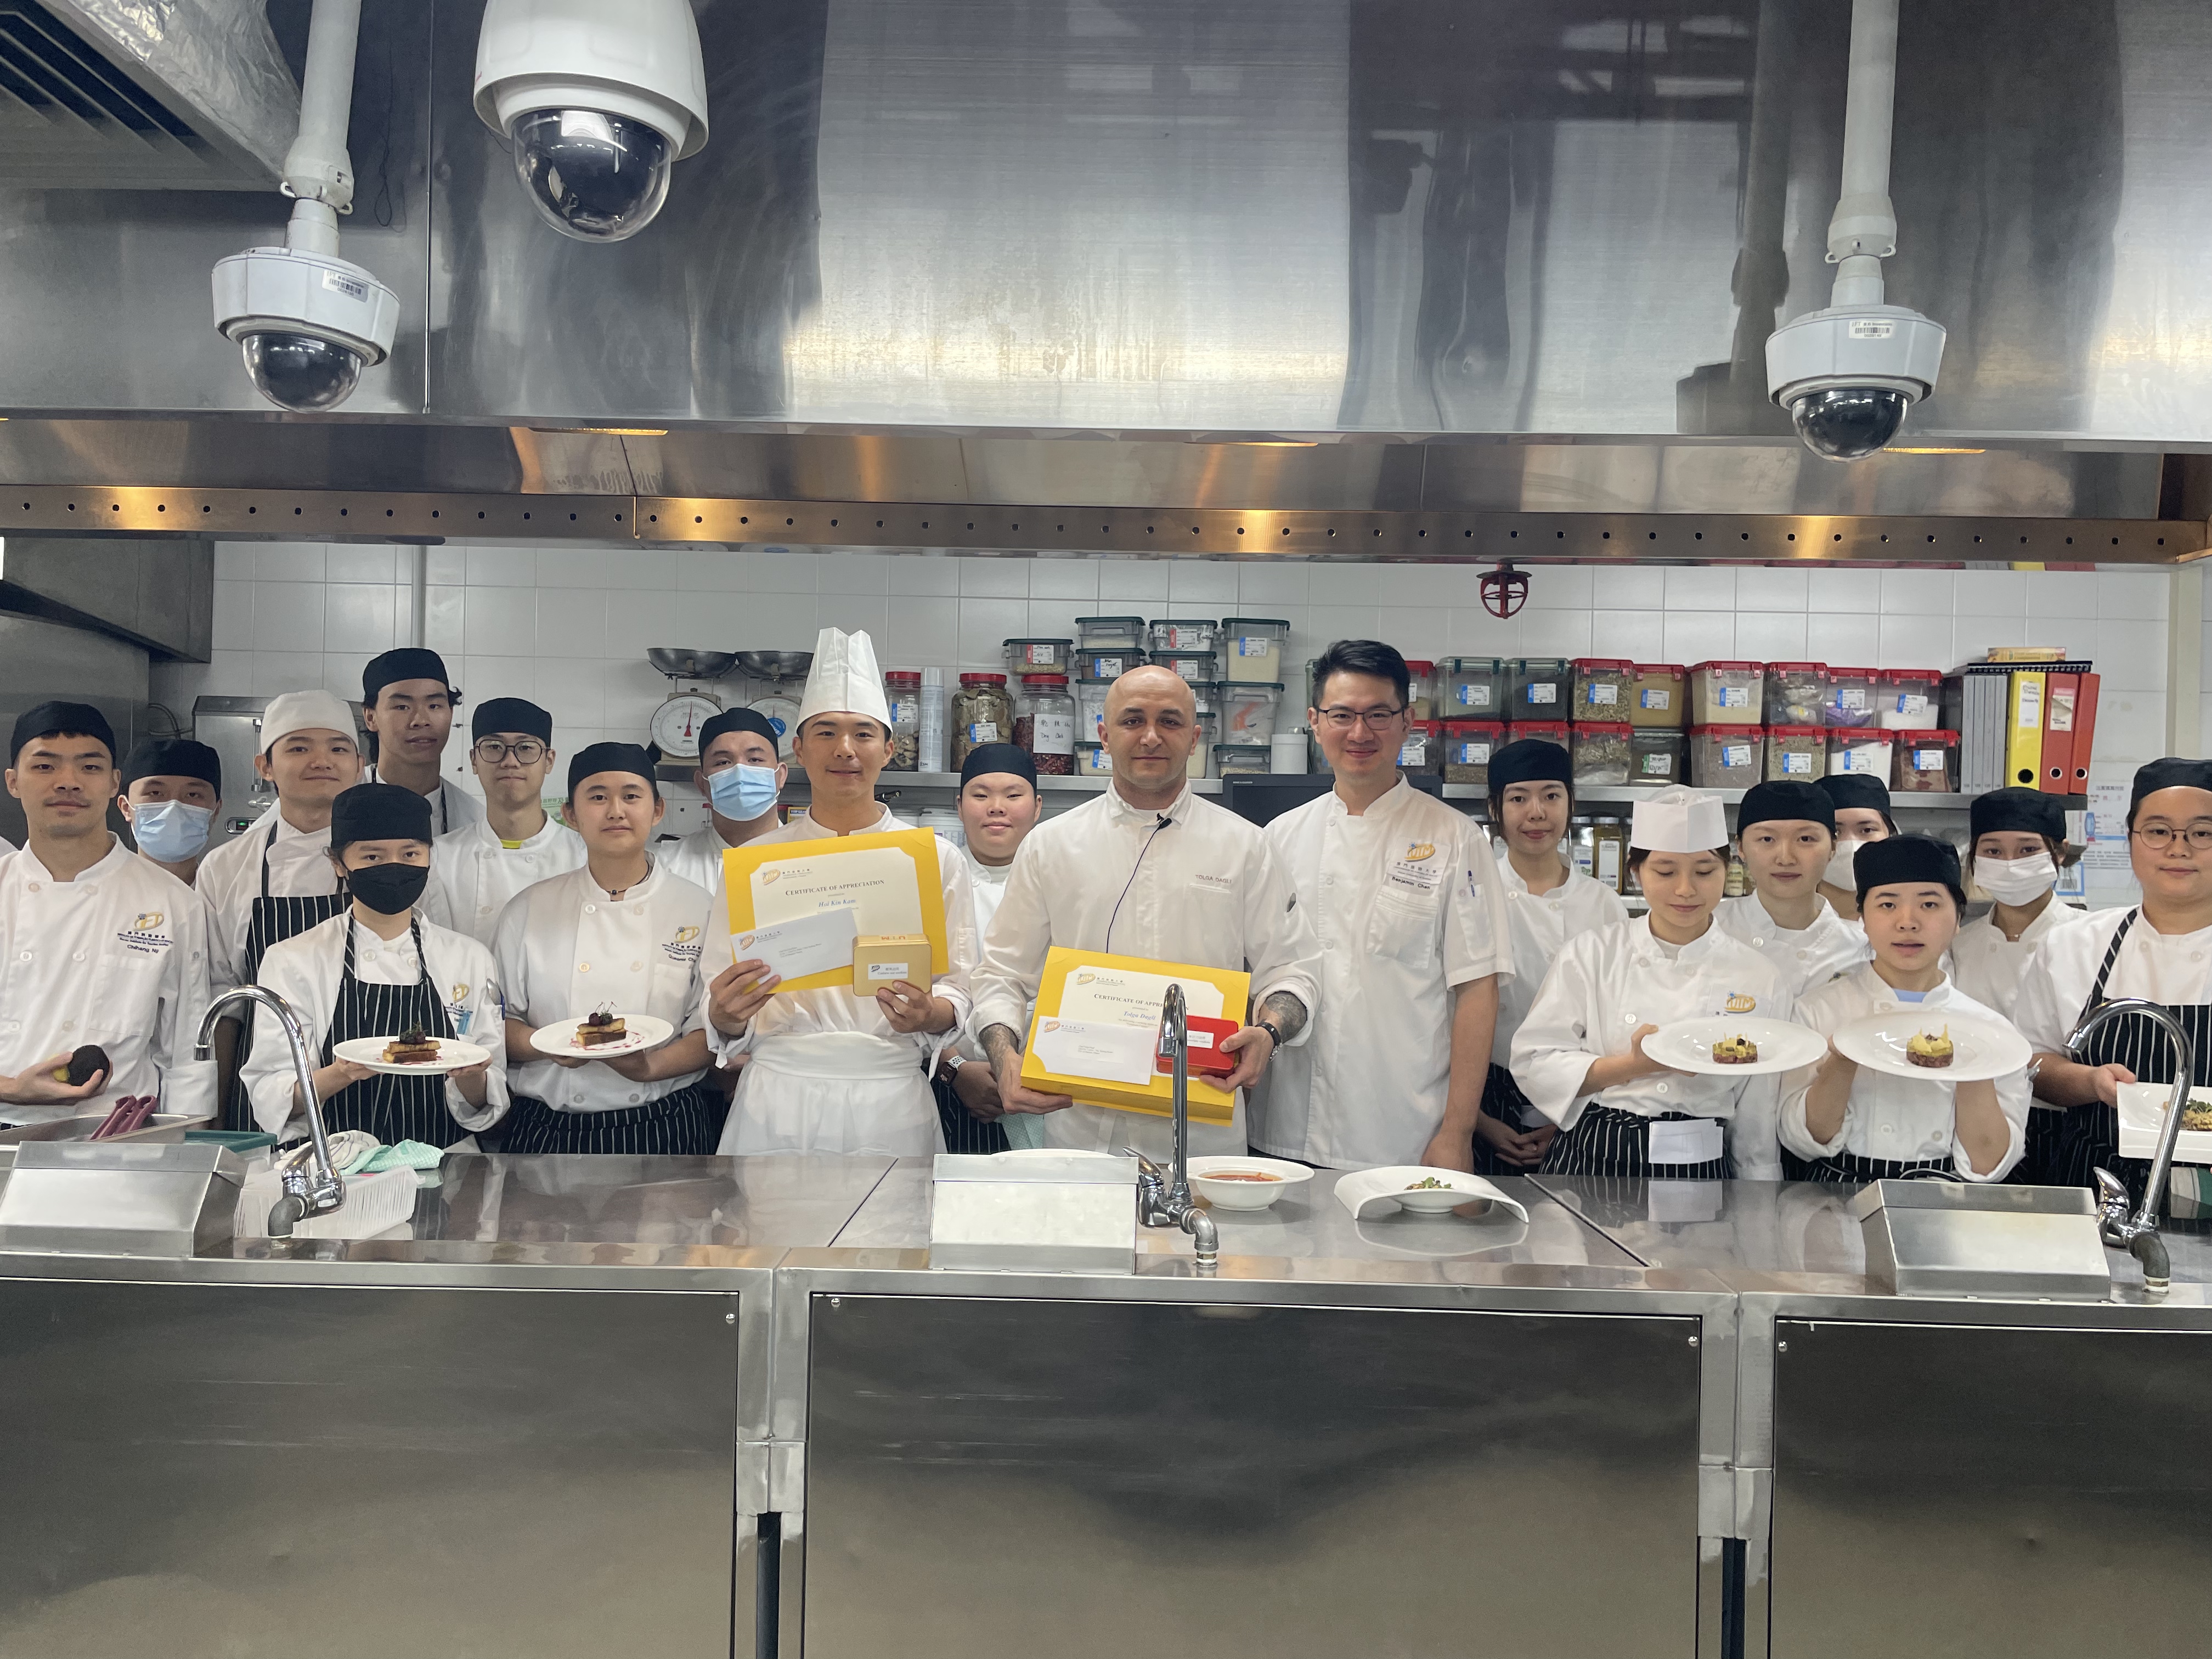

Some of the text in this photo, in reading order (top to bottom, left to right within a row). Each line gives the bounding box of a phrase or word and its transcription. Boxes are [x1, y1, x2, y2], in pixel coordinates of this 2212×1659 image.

[1392, 876, 1414, 887] Benjamin
[785, 887, 828, 896] CERTIFICATE
[839, 879, 885, 889] APPRECIATION
[1094, 994, 1134, 1003] CERTIFICATE
